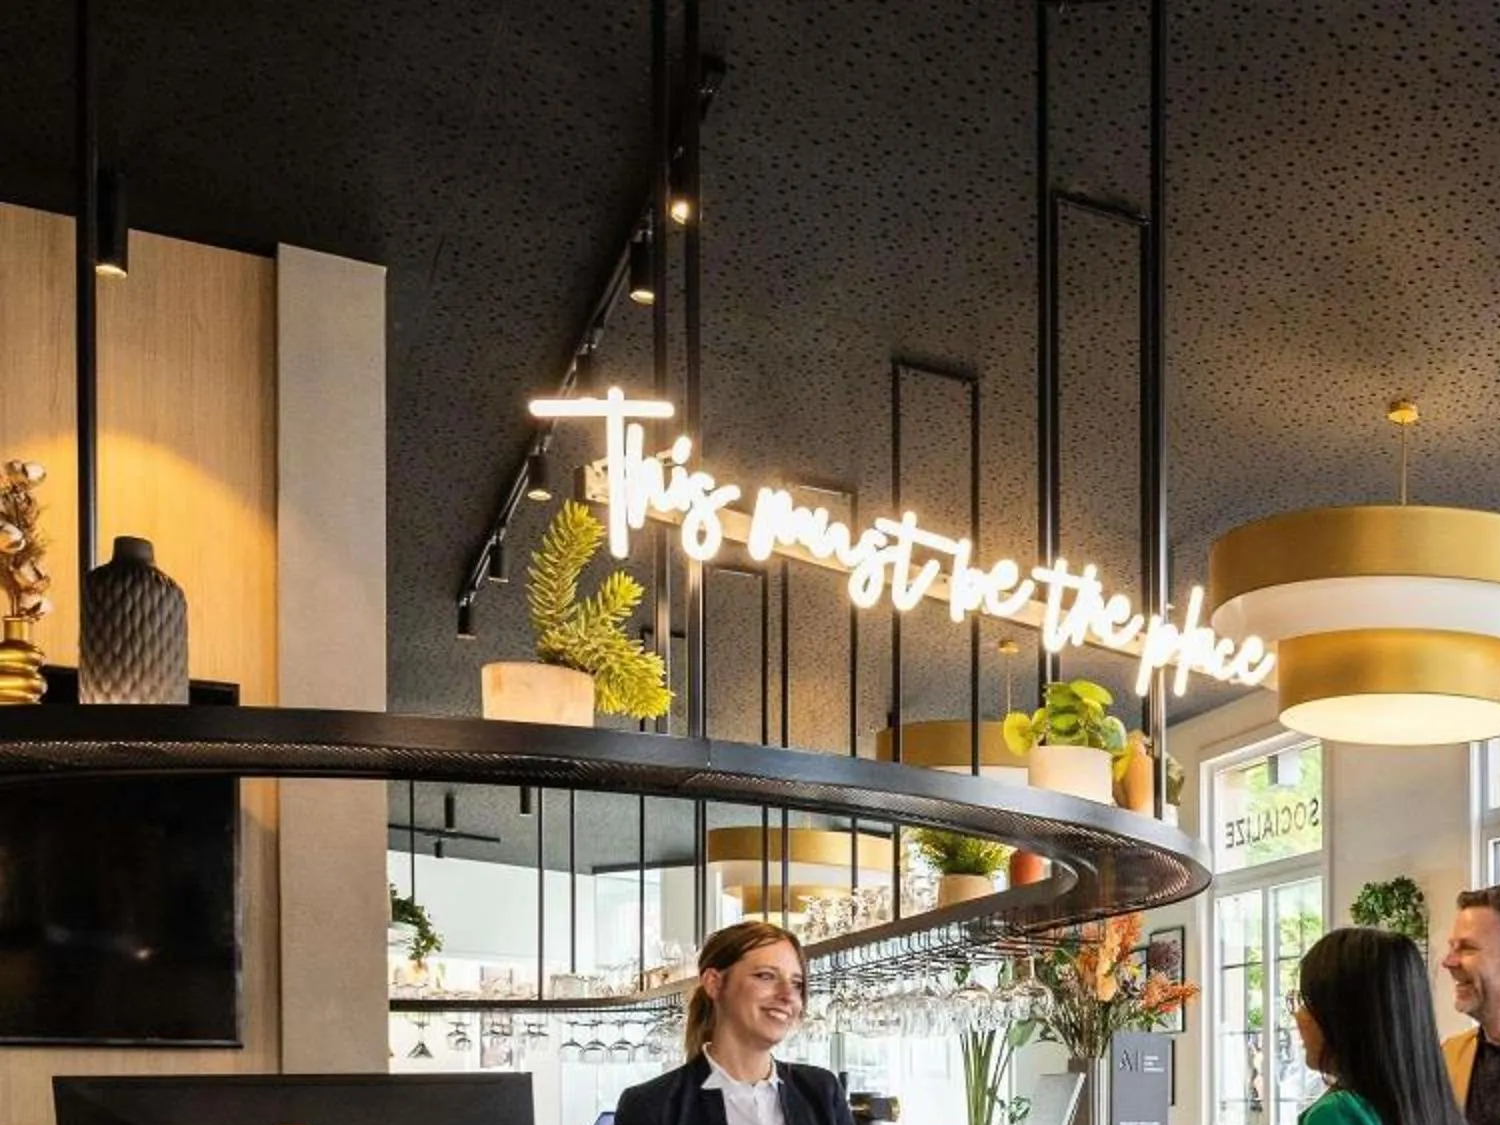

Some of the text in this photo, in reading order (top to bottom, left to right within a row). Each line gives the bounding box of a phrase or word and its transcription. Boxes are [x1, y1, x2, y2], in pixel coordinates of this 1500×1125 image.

[529, 387, 1276, 697] This must be the place
